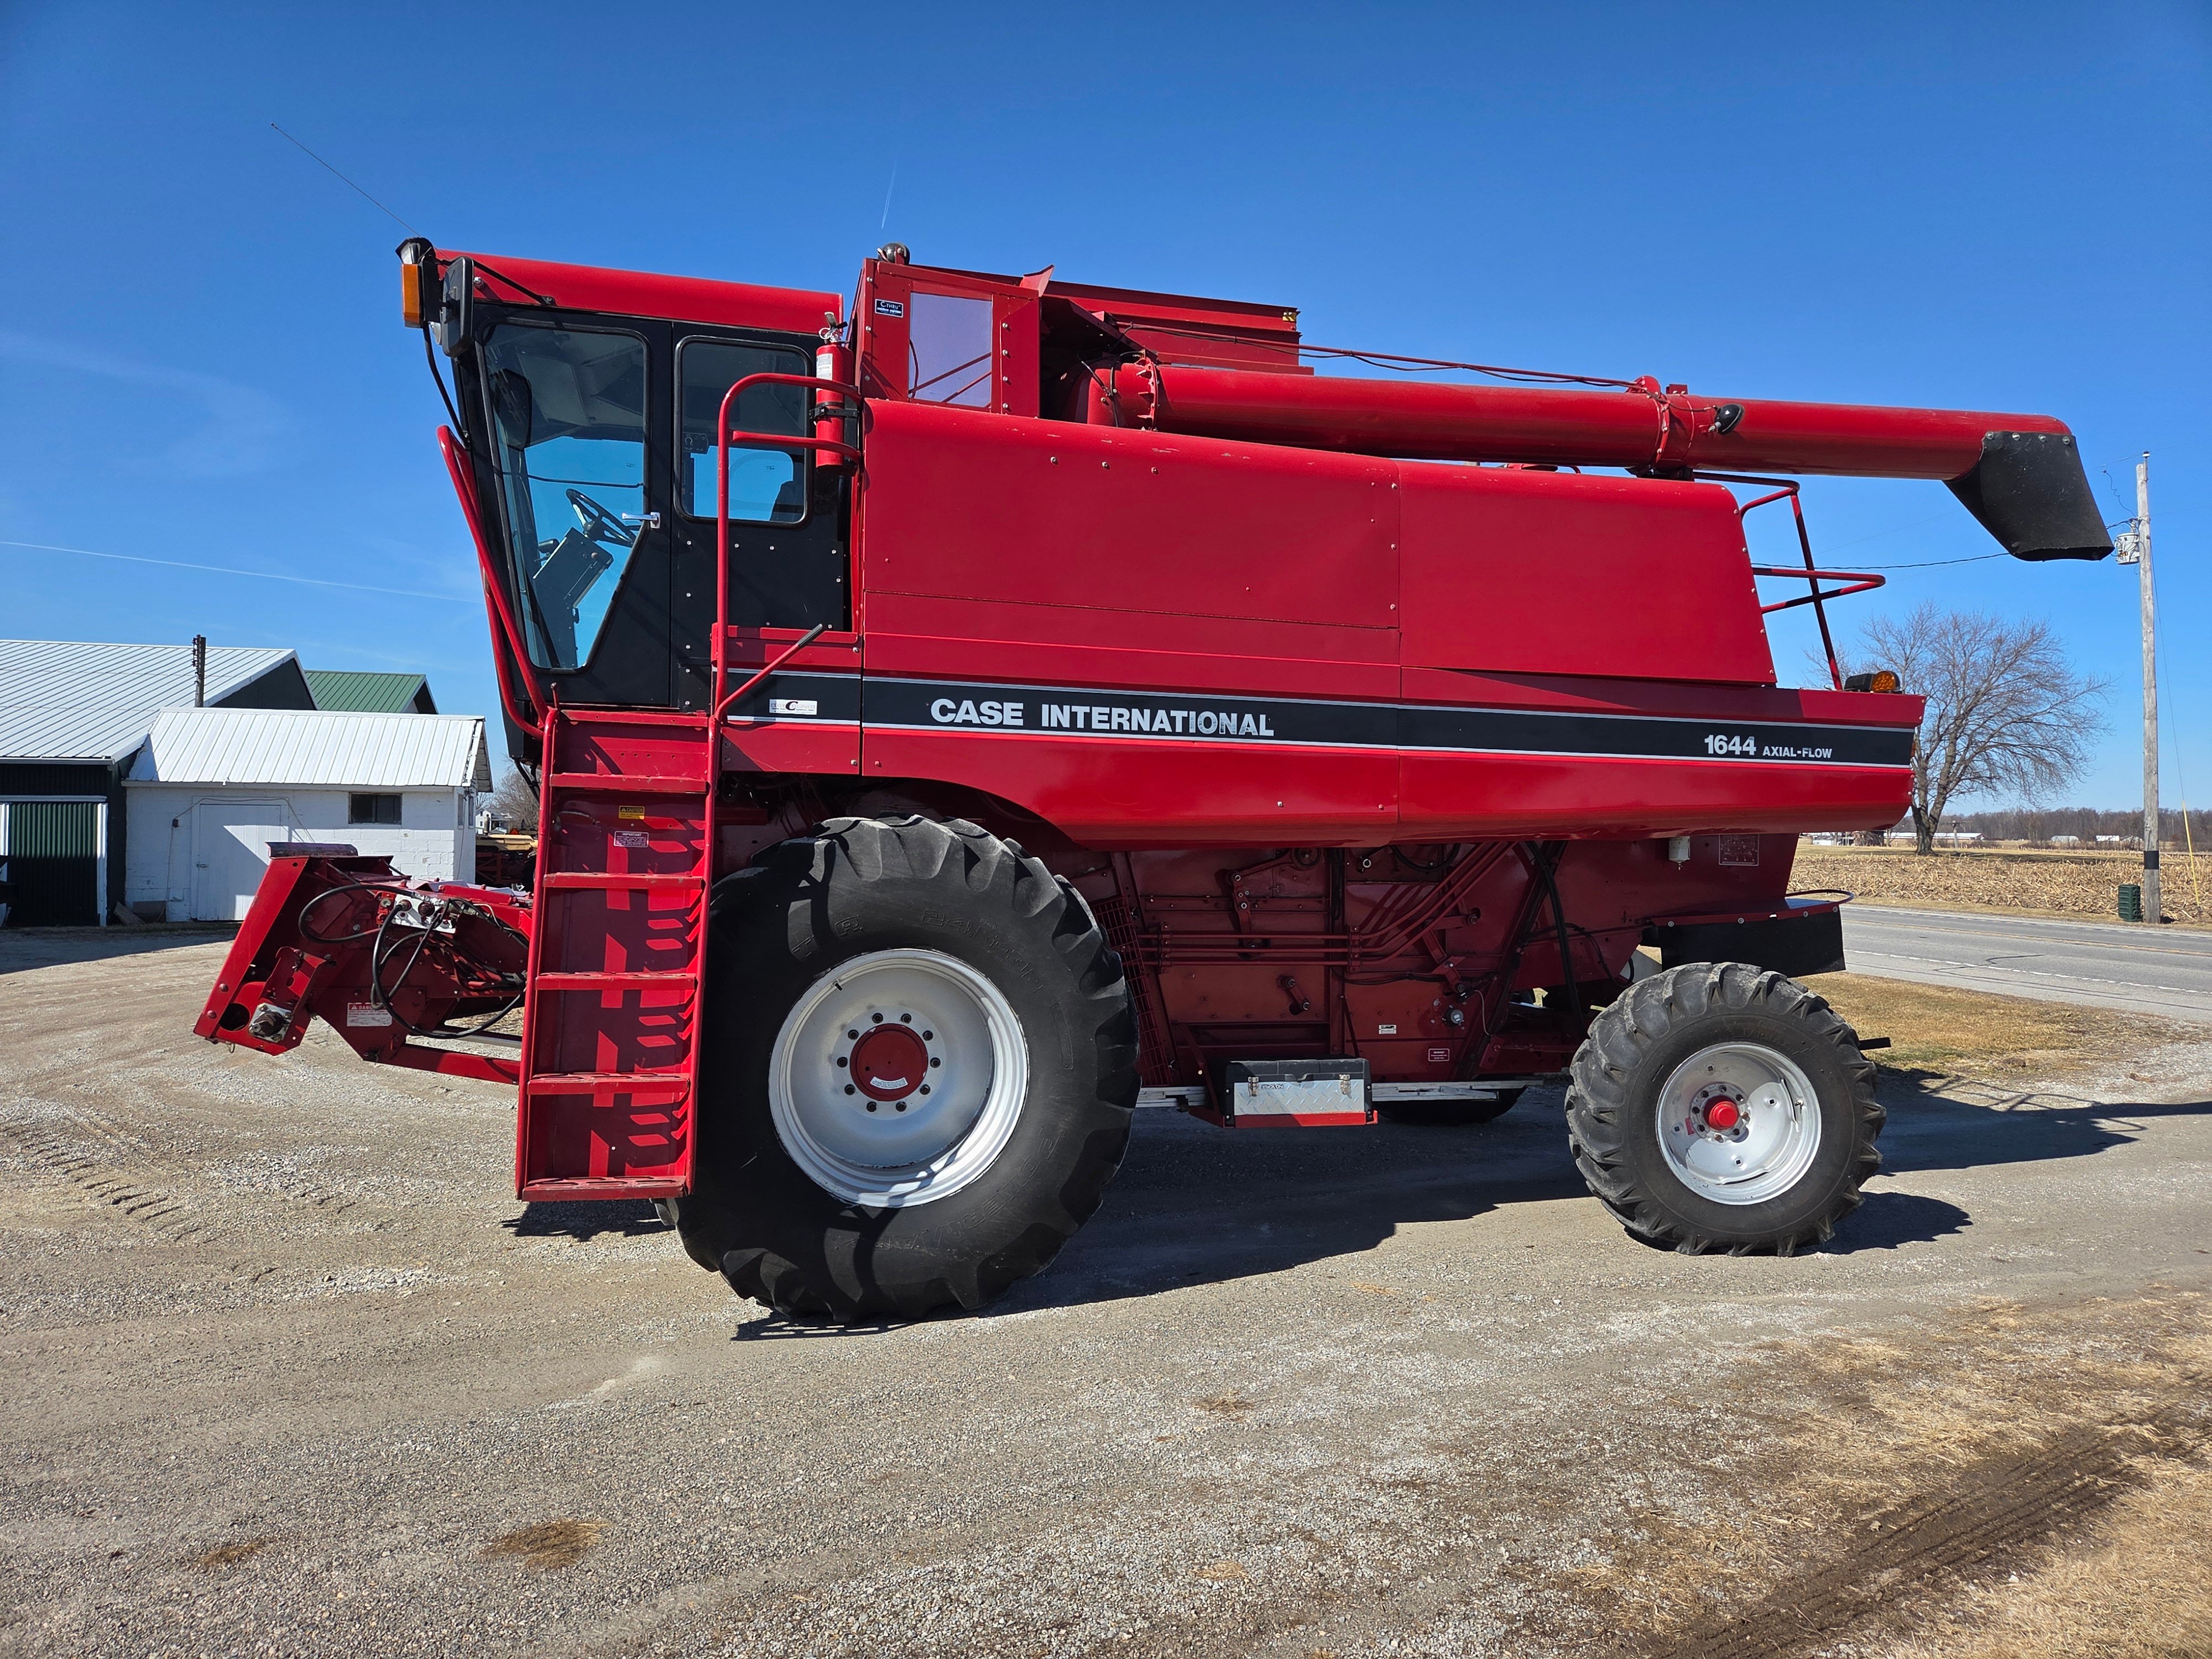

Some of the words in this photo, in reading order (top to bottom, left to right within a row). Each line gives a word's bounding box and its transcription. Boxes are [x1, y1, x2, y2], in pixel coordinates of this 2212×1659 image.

[931, 698, 1024, 726] CASE
[1042, 704, 1274, 737] INTERNATIONAL
[1704, 734, 1756, 755] 1644
[1762, 746, 1833, 758] AXIAL-FLOW
